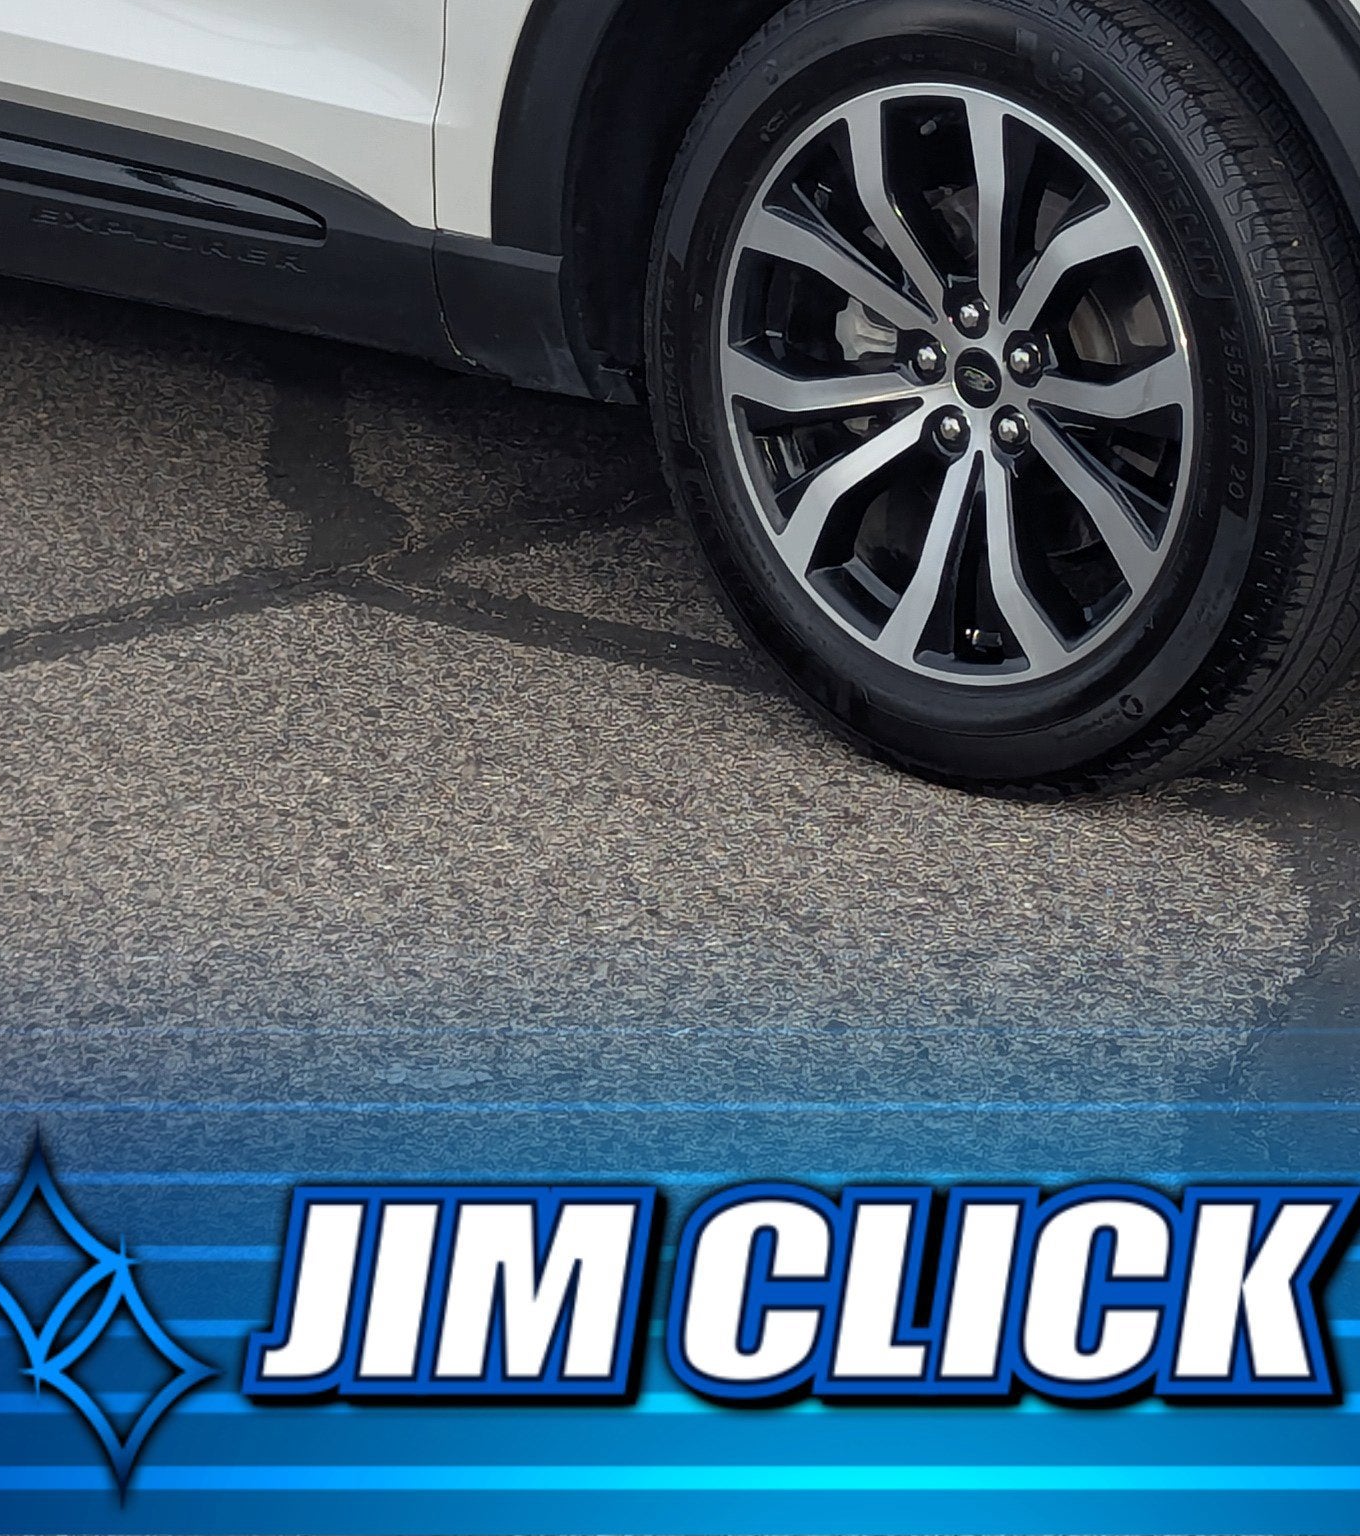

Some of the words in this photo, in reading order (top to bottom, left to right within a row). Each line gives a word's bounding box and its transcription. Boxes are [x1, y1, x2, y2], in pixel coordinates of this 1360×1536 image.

[32, 209, 308, 275] EXPLORER
[1220, 325, 1250, 426] 255/55
[1228, 464, 1248, 500] 20
